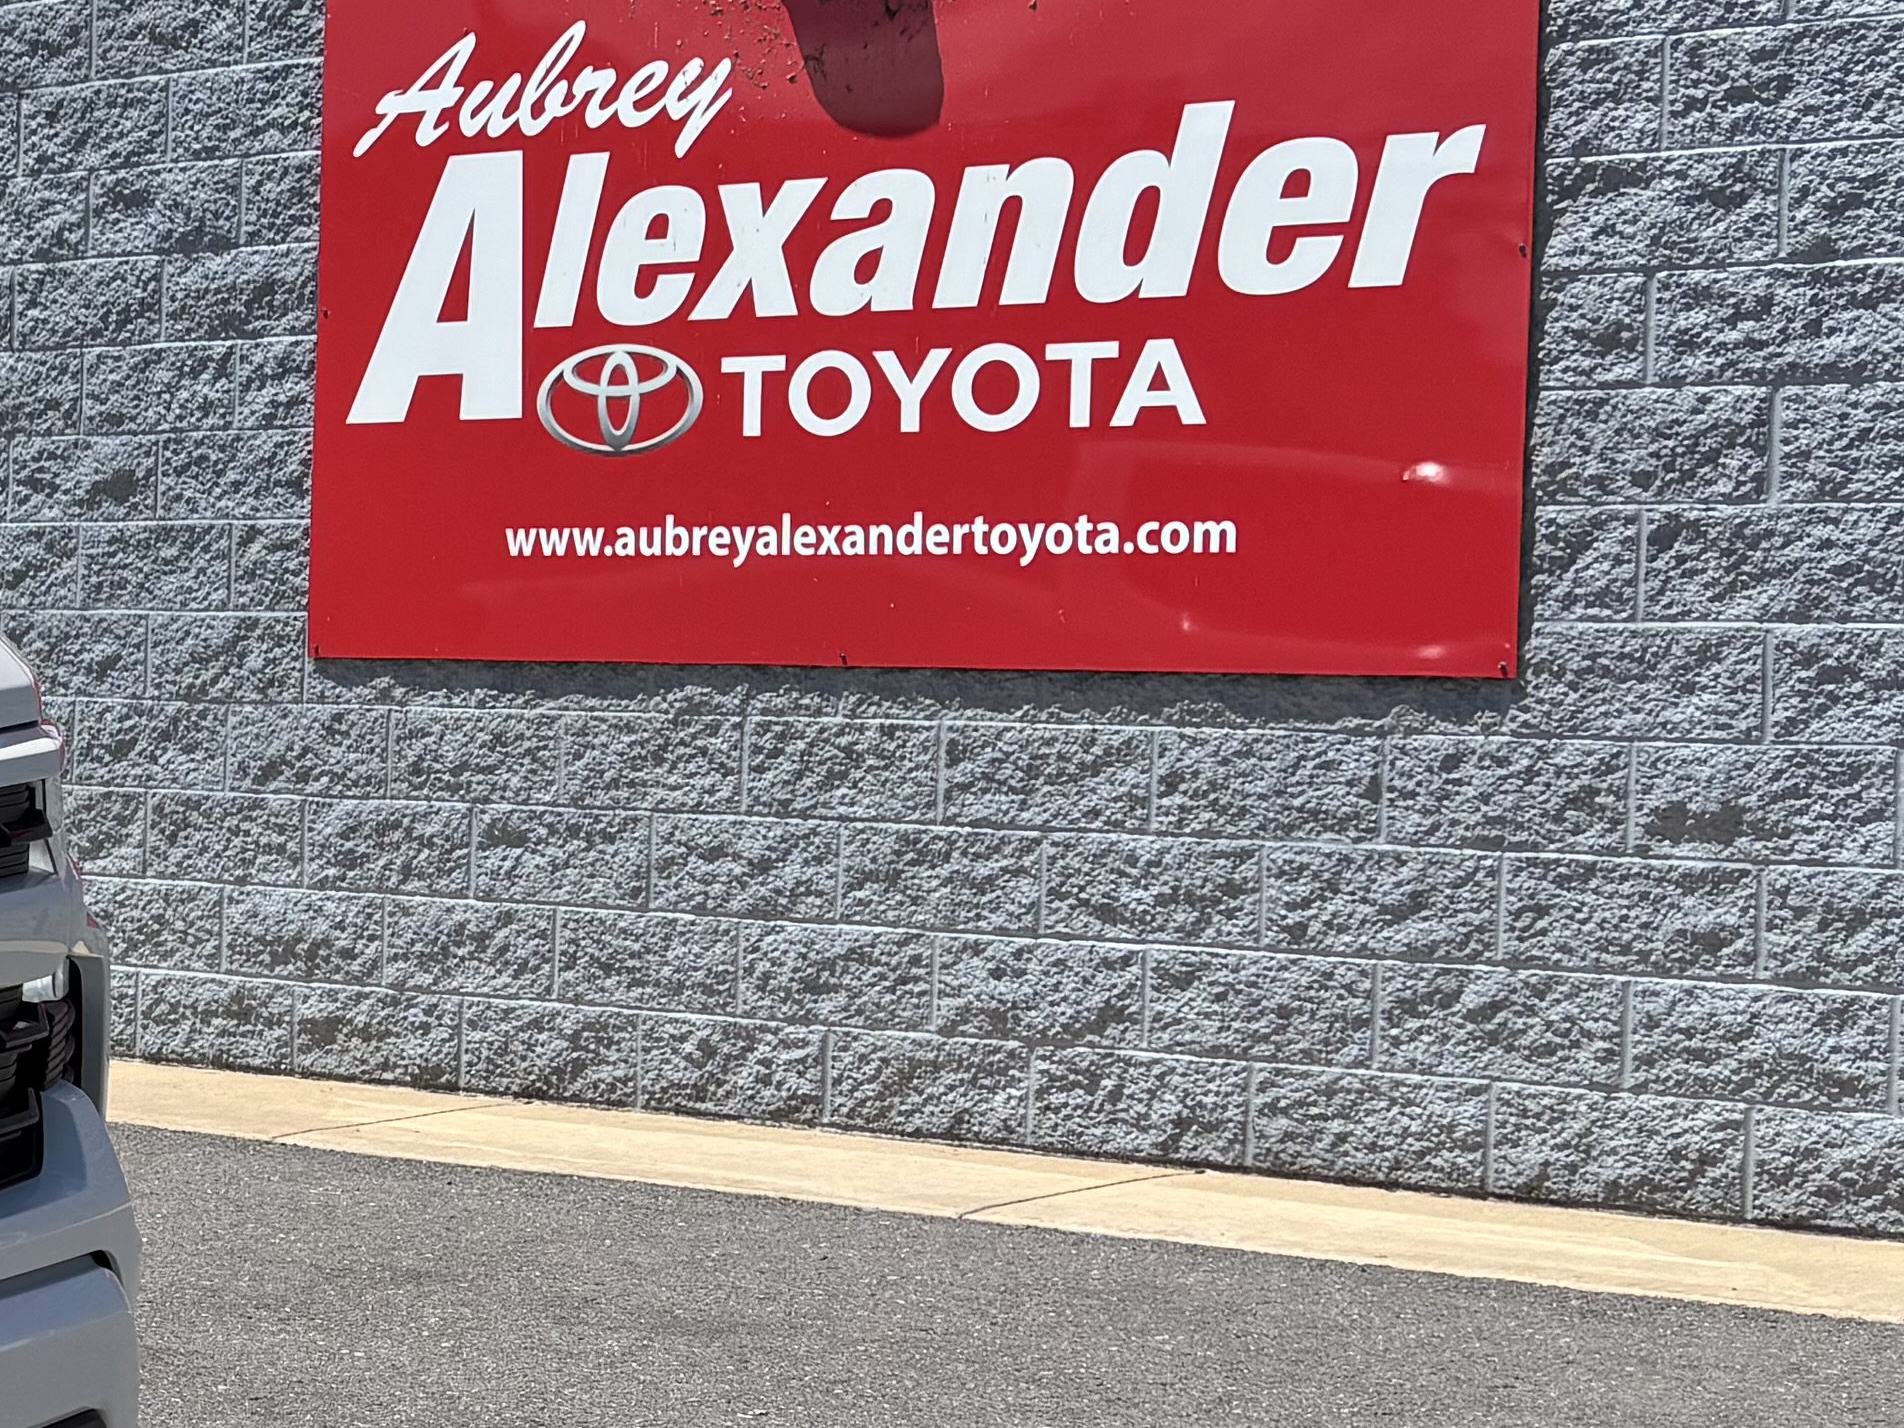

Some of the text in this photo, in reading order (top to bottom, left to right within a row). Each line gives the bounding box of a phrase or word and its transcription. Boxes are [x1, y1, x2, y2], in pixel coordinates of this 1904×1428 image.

[353, 20, 732, 158] Aubrey
[345, 99, 1486, 425] Alexander
[721, 338, 1207, 438] TOYOTA
[505, 511, 1238, 569] www.aubreyalexandertoyota.com
